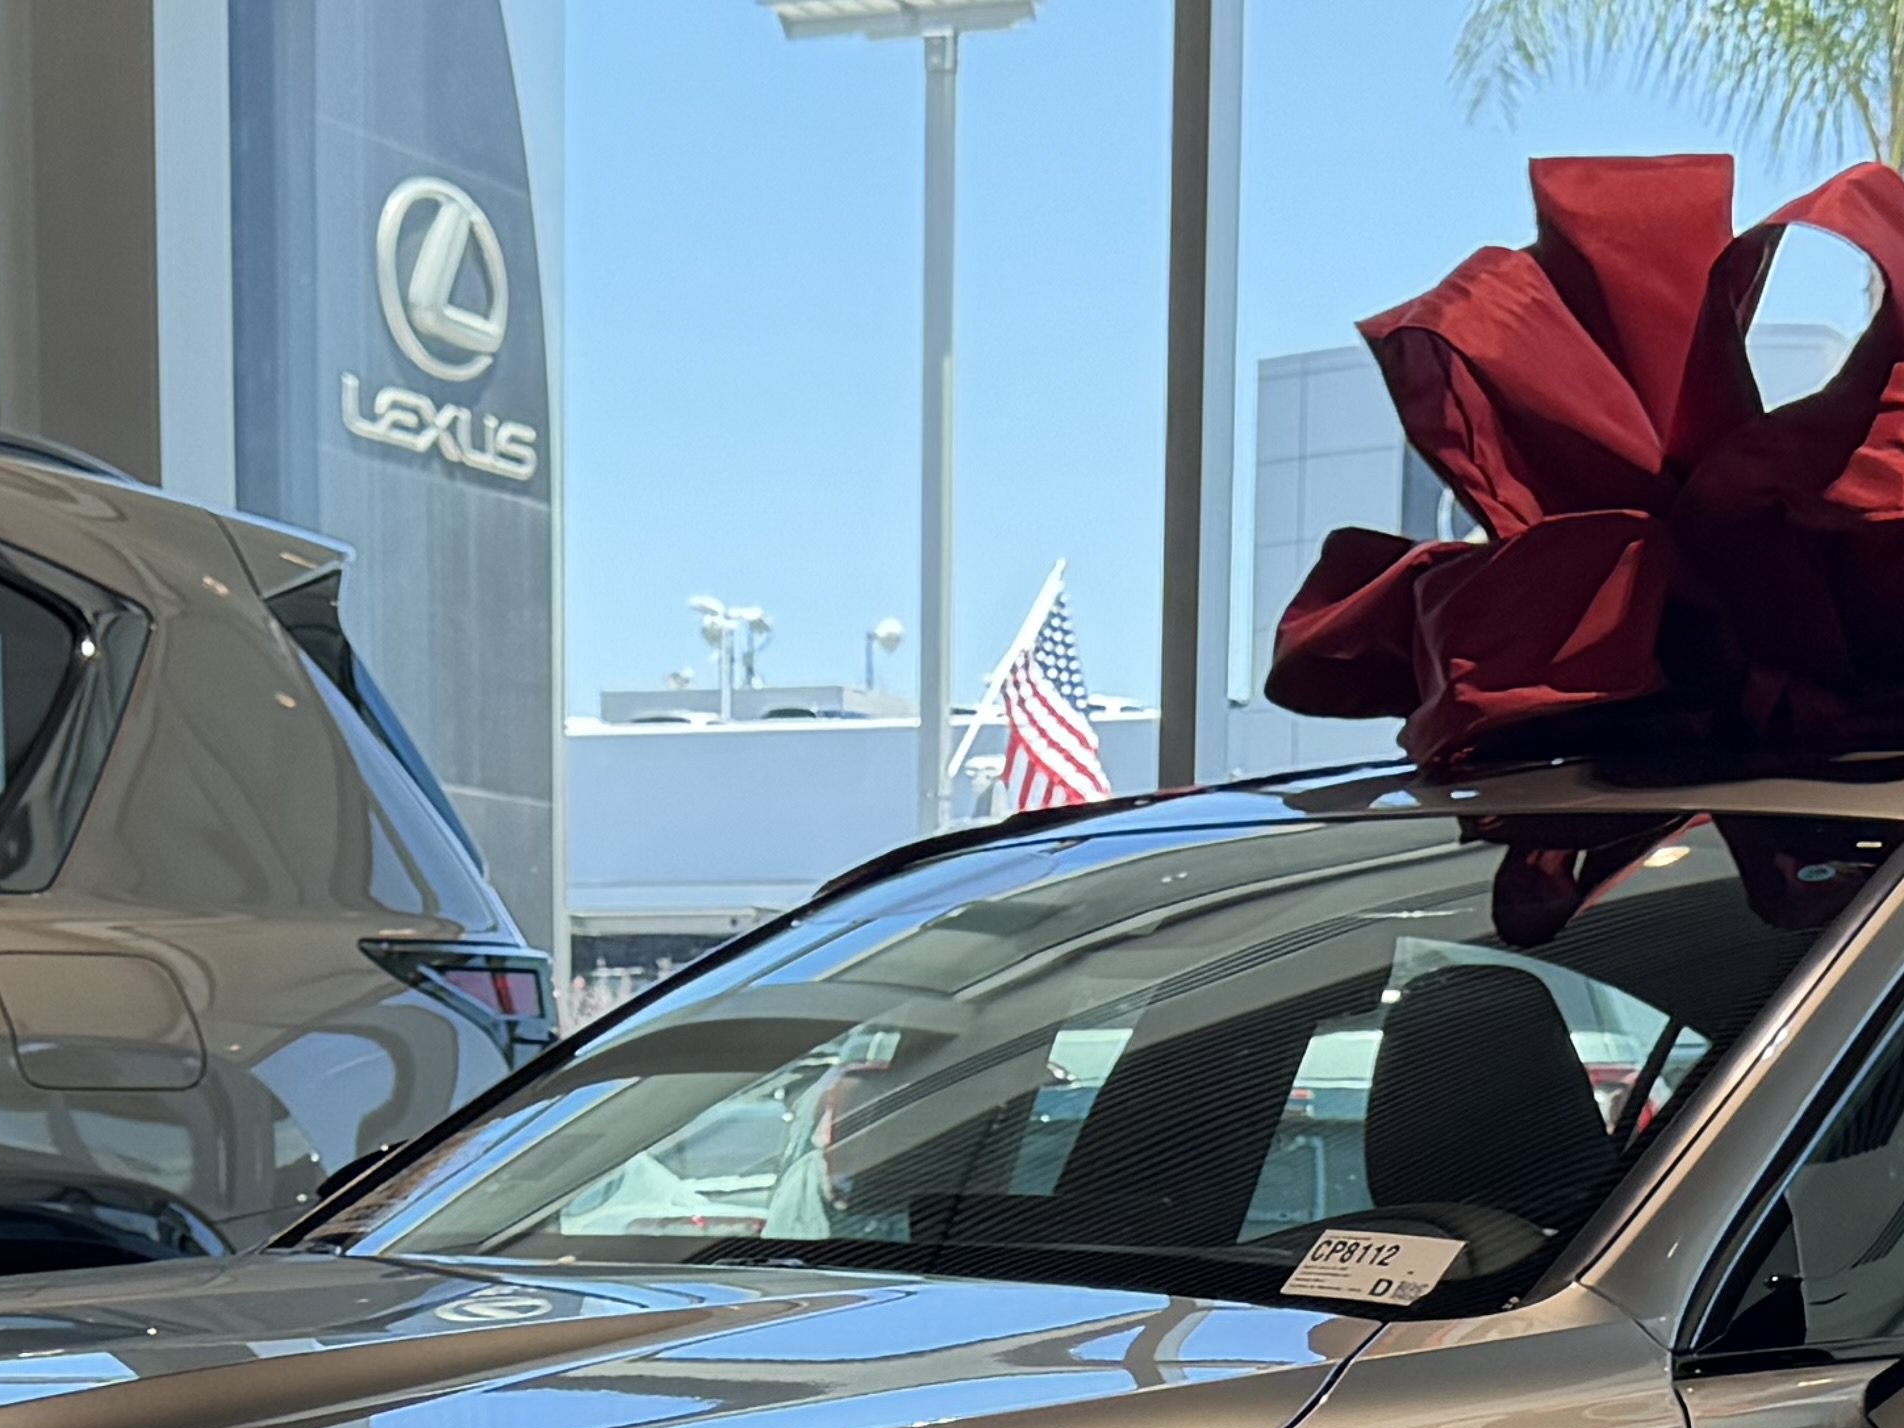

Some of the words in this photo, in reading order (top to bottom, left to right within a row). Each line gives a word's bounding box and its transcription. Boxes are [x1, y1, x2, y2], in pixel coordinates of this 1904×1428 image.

[340, 371, 538, 482] LEXUS
[1311, 1240, 1400, 1266] CP8112
[1369, 1278, 1393, 1296] D
